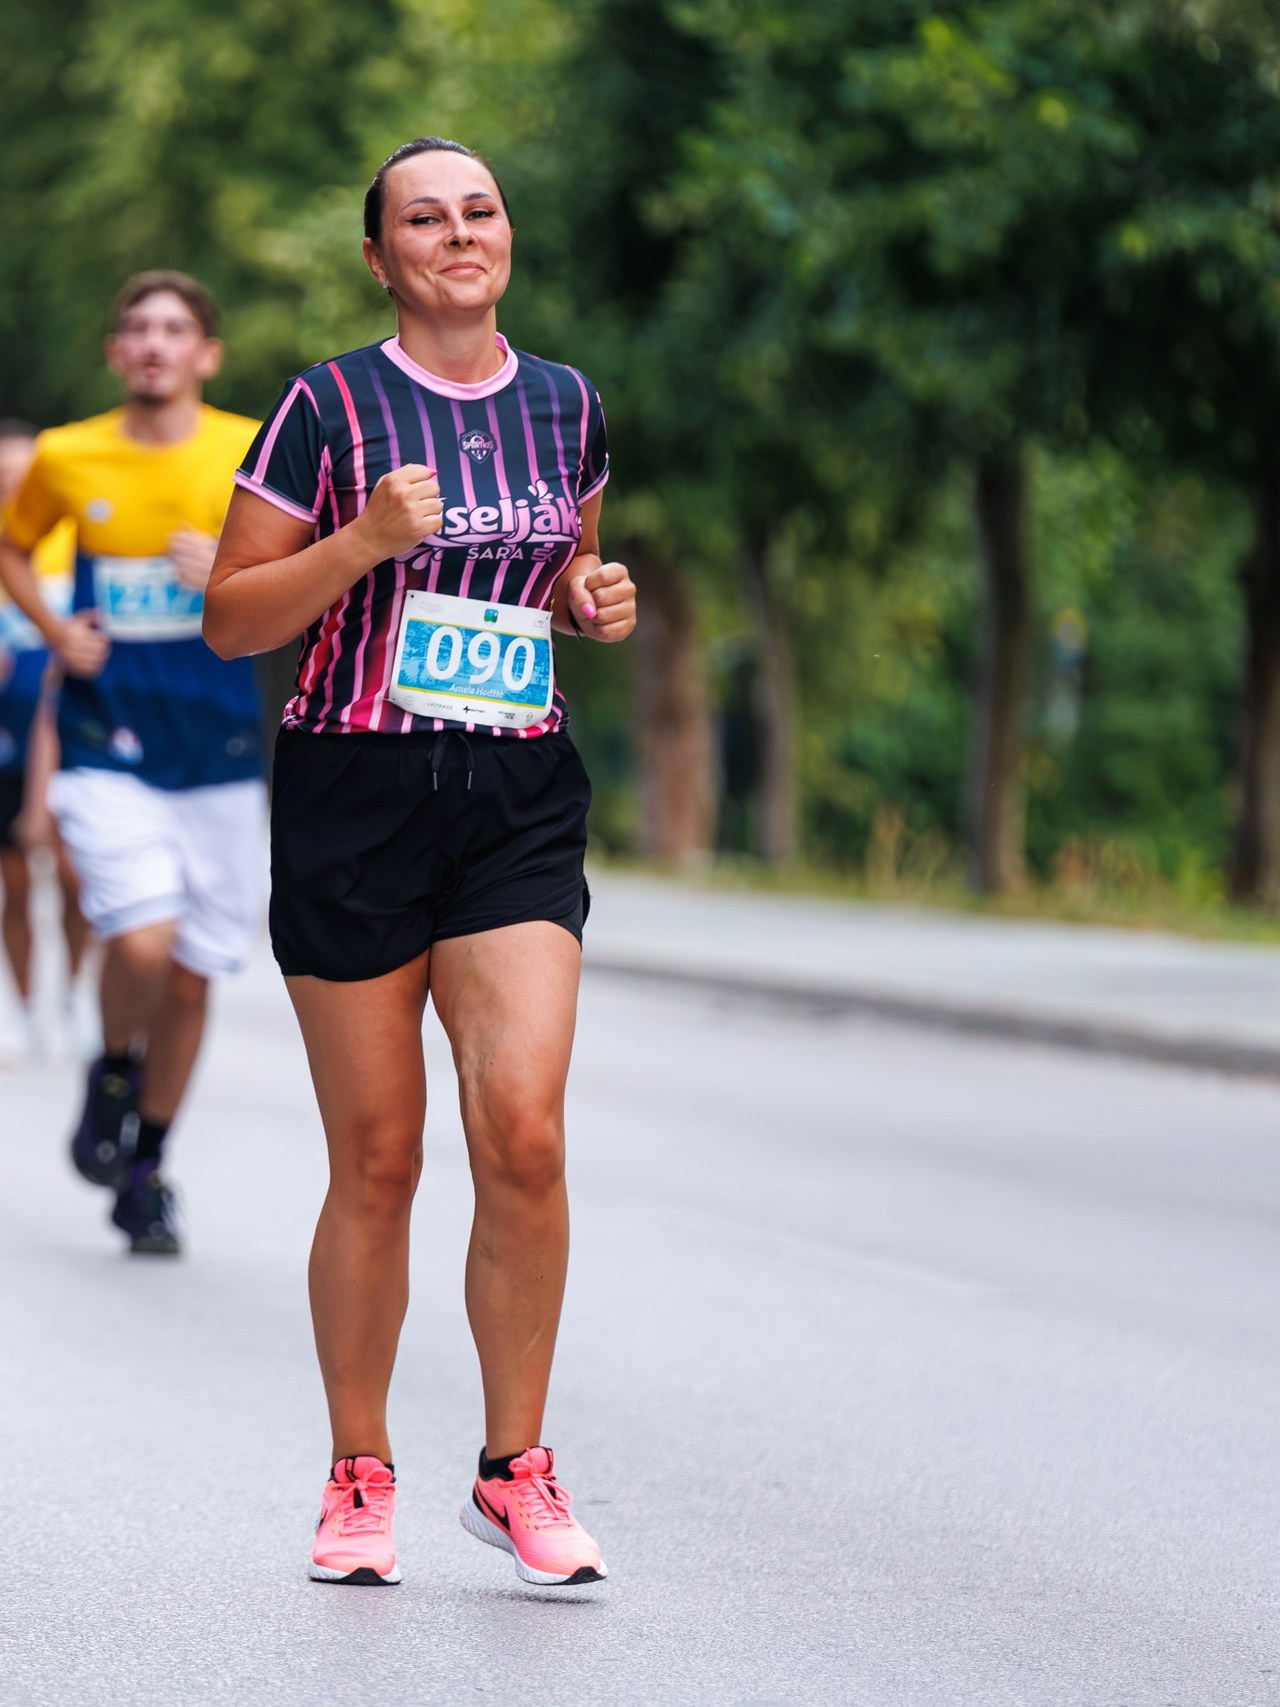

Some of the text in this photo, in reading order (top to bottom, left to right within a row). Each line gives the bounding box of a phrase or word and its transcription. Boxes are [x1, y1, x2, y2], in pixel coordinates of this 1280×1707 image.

[436, 497, 580, 543] seljak
[467, 546, 524, 560] SARA
[426, 625, 535, 691] 090
[449, 683, 475, 695] Amela
